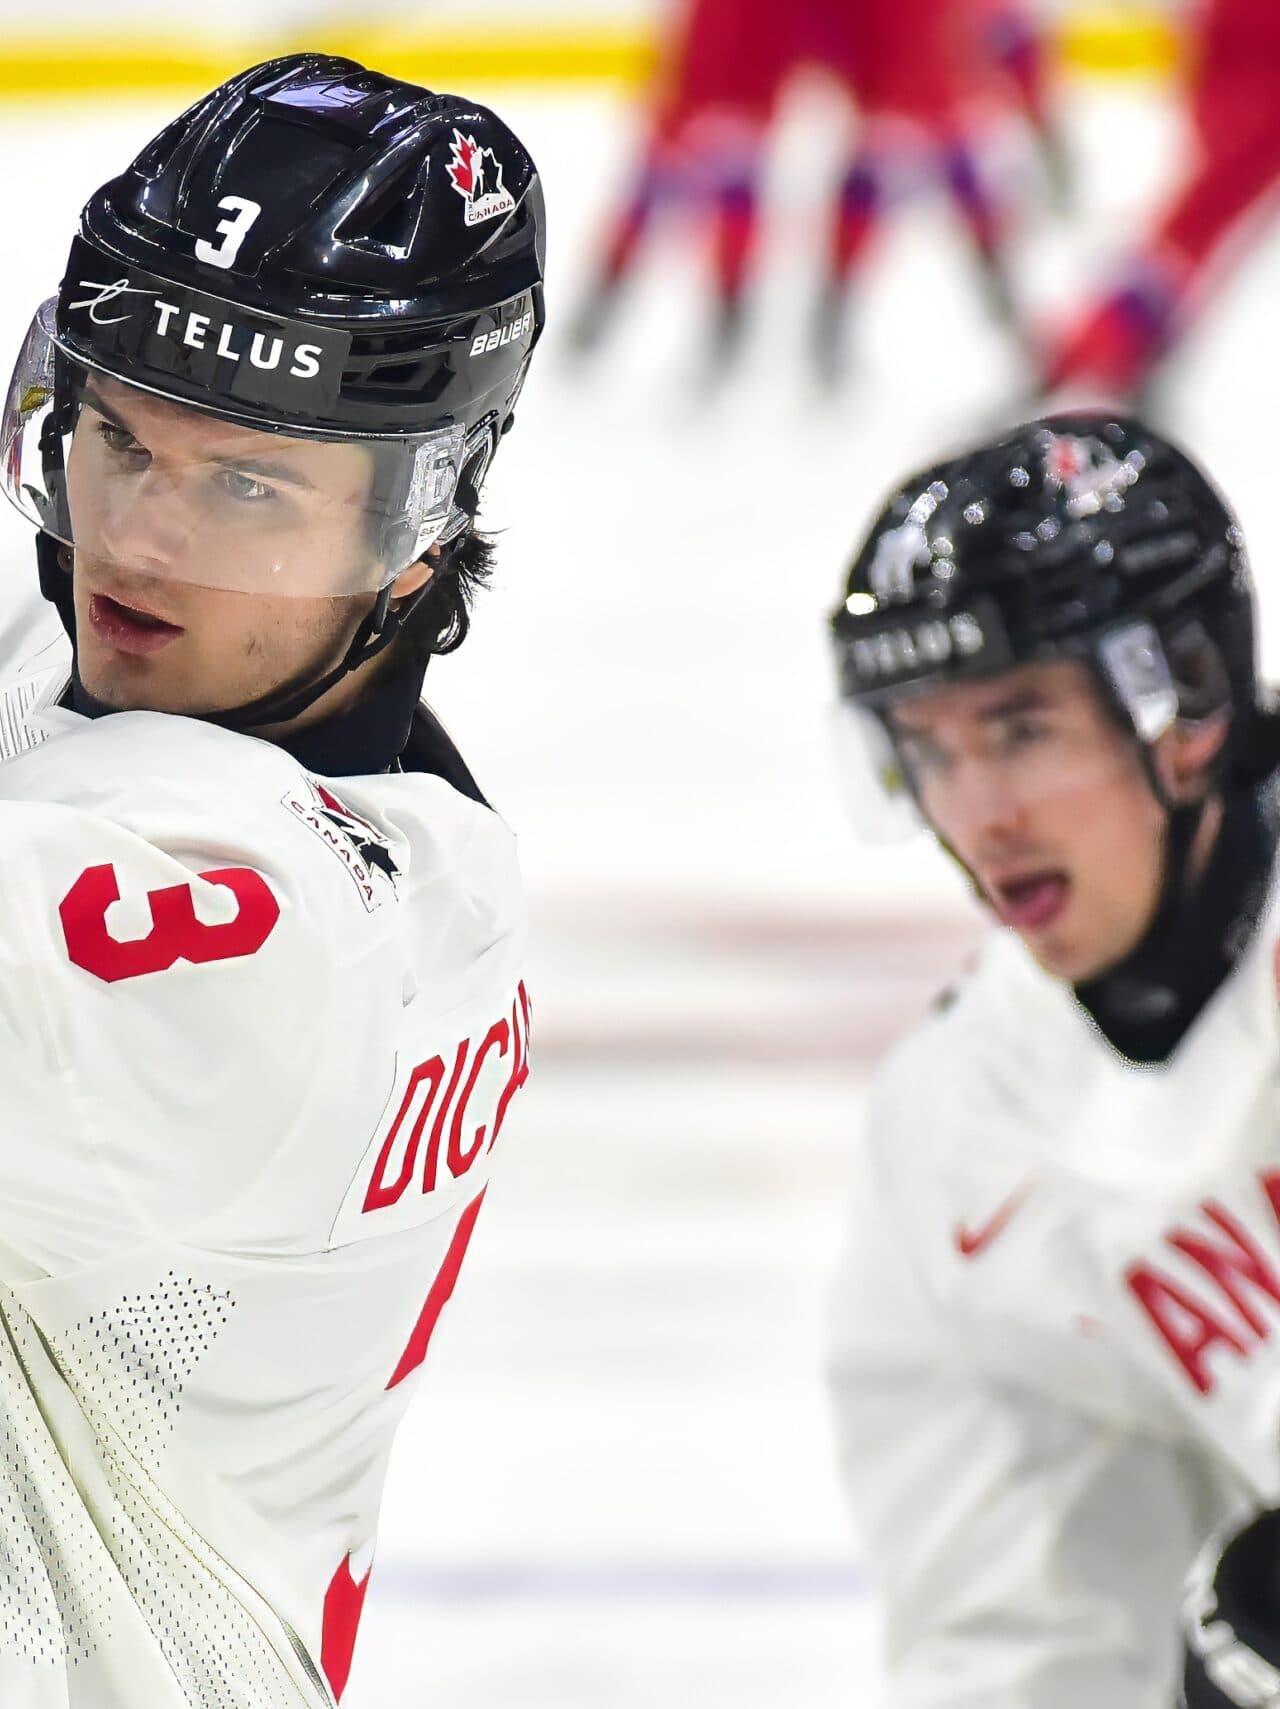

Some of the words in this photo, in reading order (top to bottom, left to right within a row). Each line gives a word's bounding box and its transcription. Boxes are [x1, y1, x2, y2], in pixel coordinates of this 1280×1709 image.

[194, 195, 261, 270] 3
[468, 199, 514, 222] CANADA
[153, 299, 324, 380] TELUS
[469, 312, 533, 358] BAUER
[290, 800, 373, 901] CANADA
[59, 863, 280, 983] 3
[1124, 1164, 1280, 1397] AN
